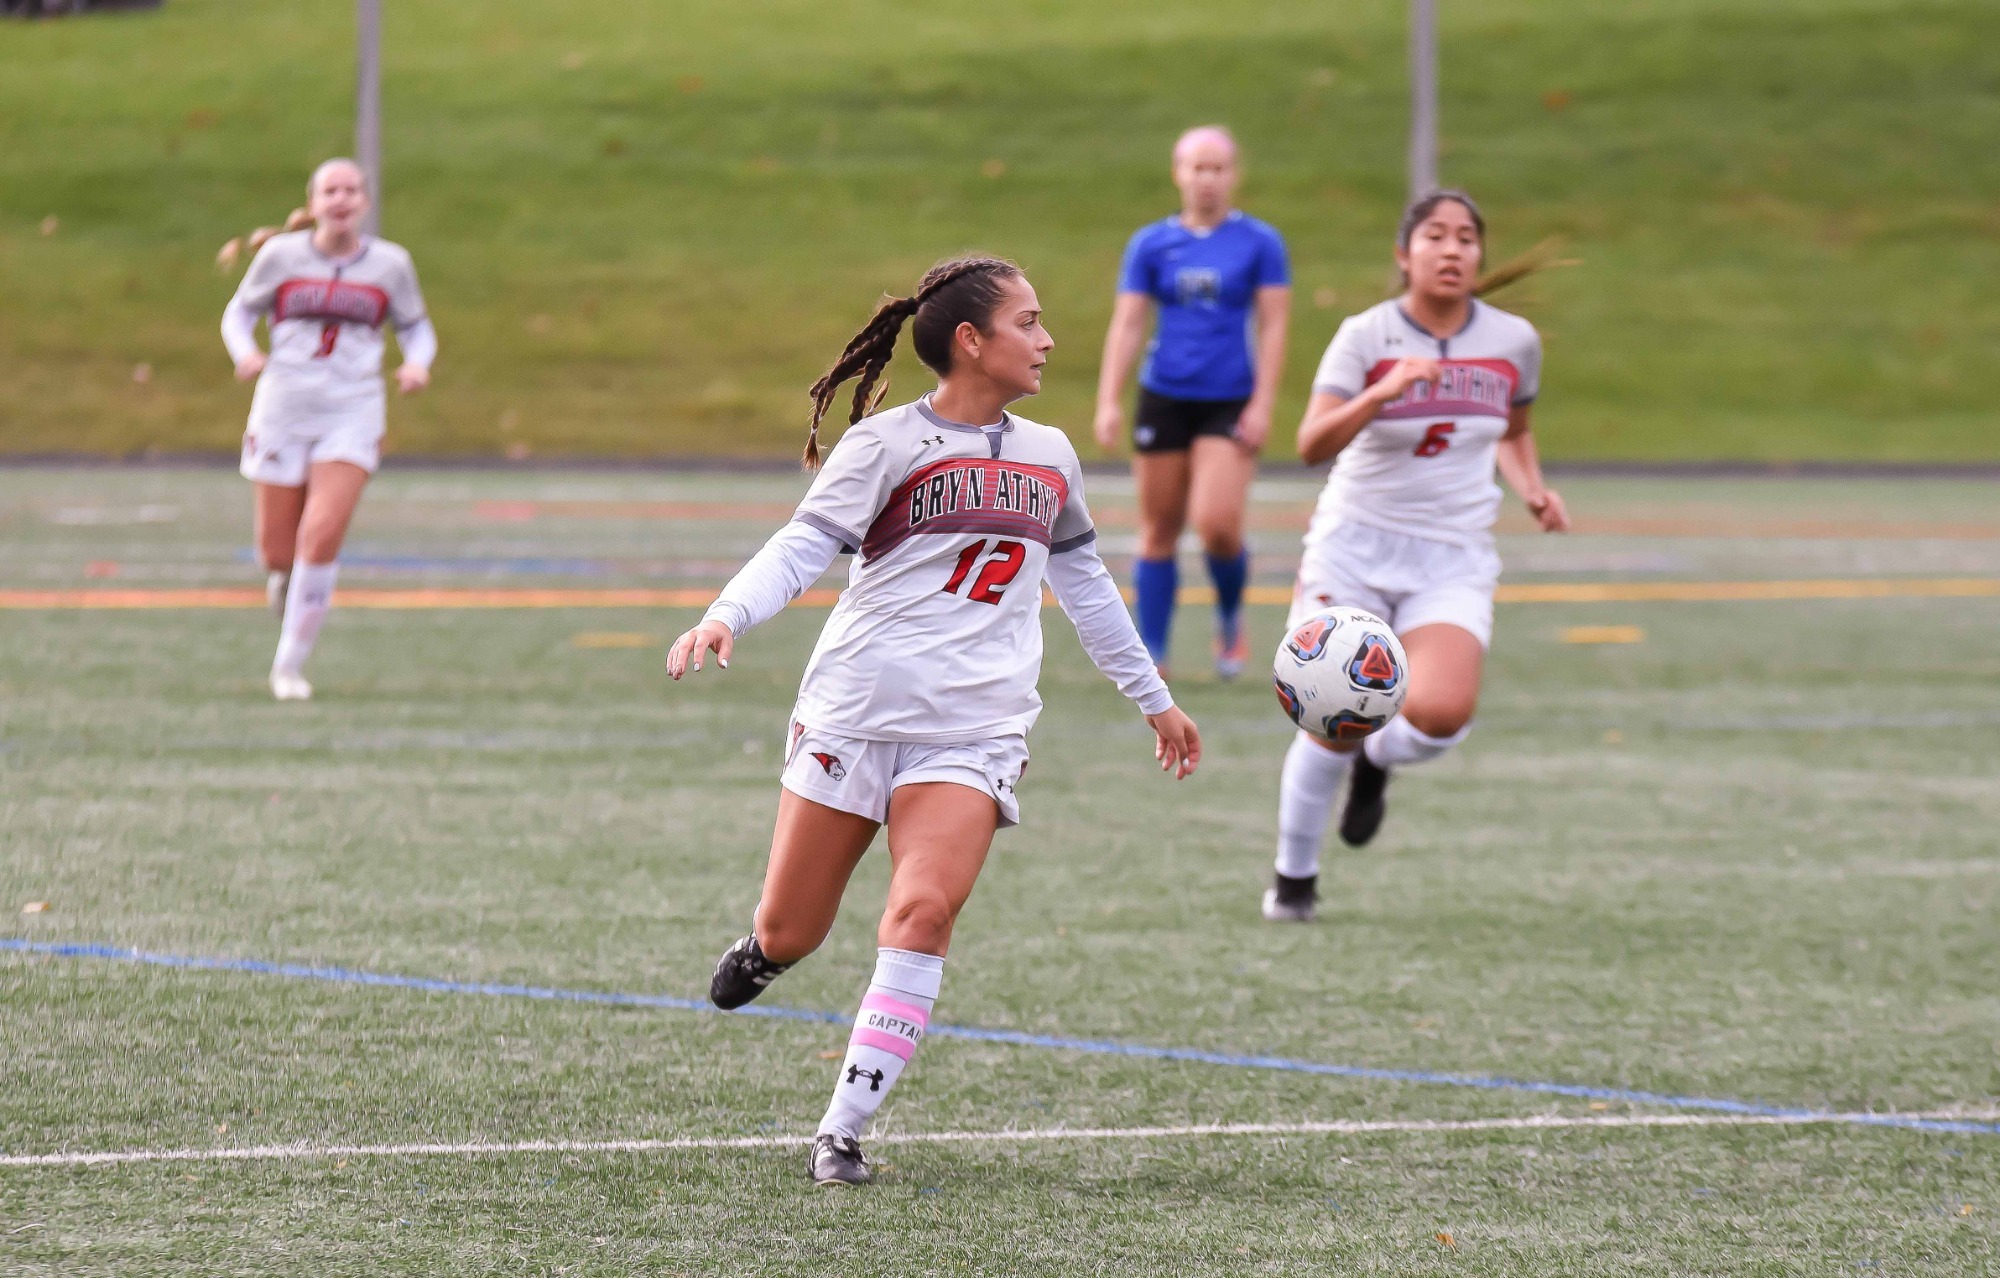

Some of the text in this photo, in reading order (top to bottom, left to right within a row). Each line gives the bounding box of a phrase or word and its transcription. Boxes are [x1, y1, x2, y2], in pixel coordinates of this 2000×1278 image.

[1413, 422, 1456, 458] 6
[909, 467, 985, 528] BRYN
[941, 538, 1027, 606] 12
